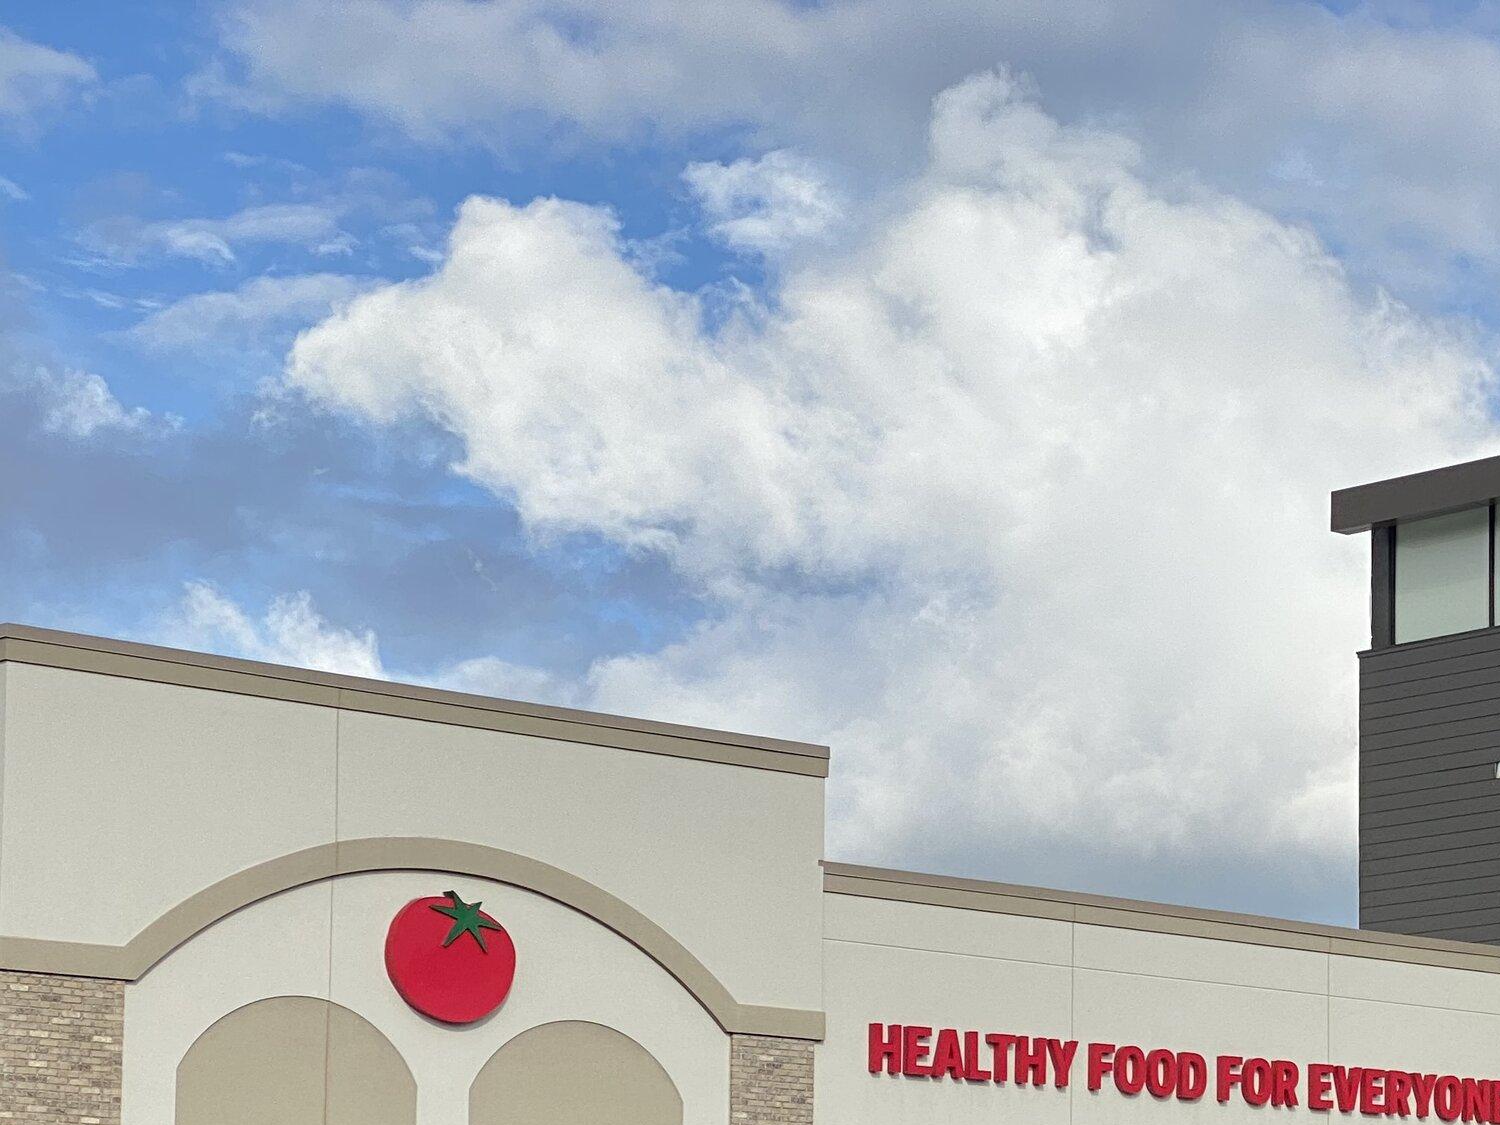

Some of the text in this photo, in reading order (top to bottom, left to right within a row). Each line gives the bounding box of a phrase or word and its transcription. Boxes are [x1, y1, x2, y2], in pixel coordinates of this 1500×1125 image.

[868, 1022, 1079, 1088] HEALTHY
[1087, 1042, 1207, 1101] FOOD
[1216, 1055, 1299, 1109] FOR
